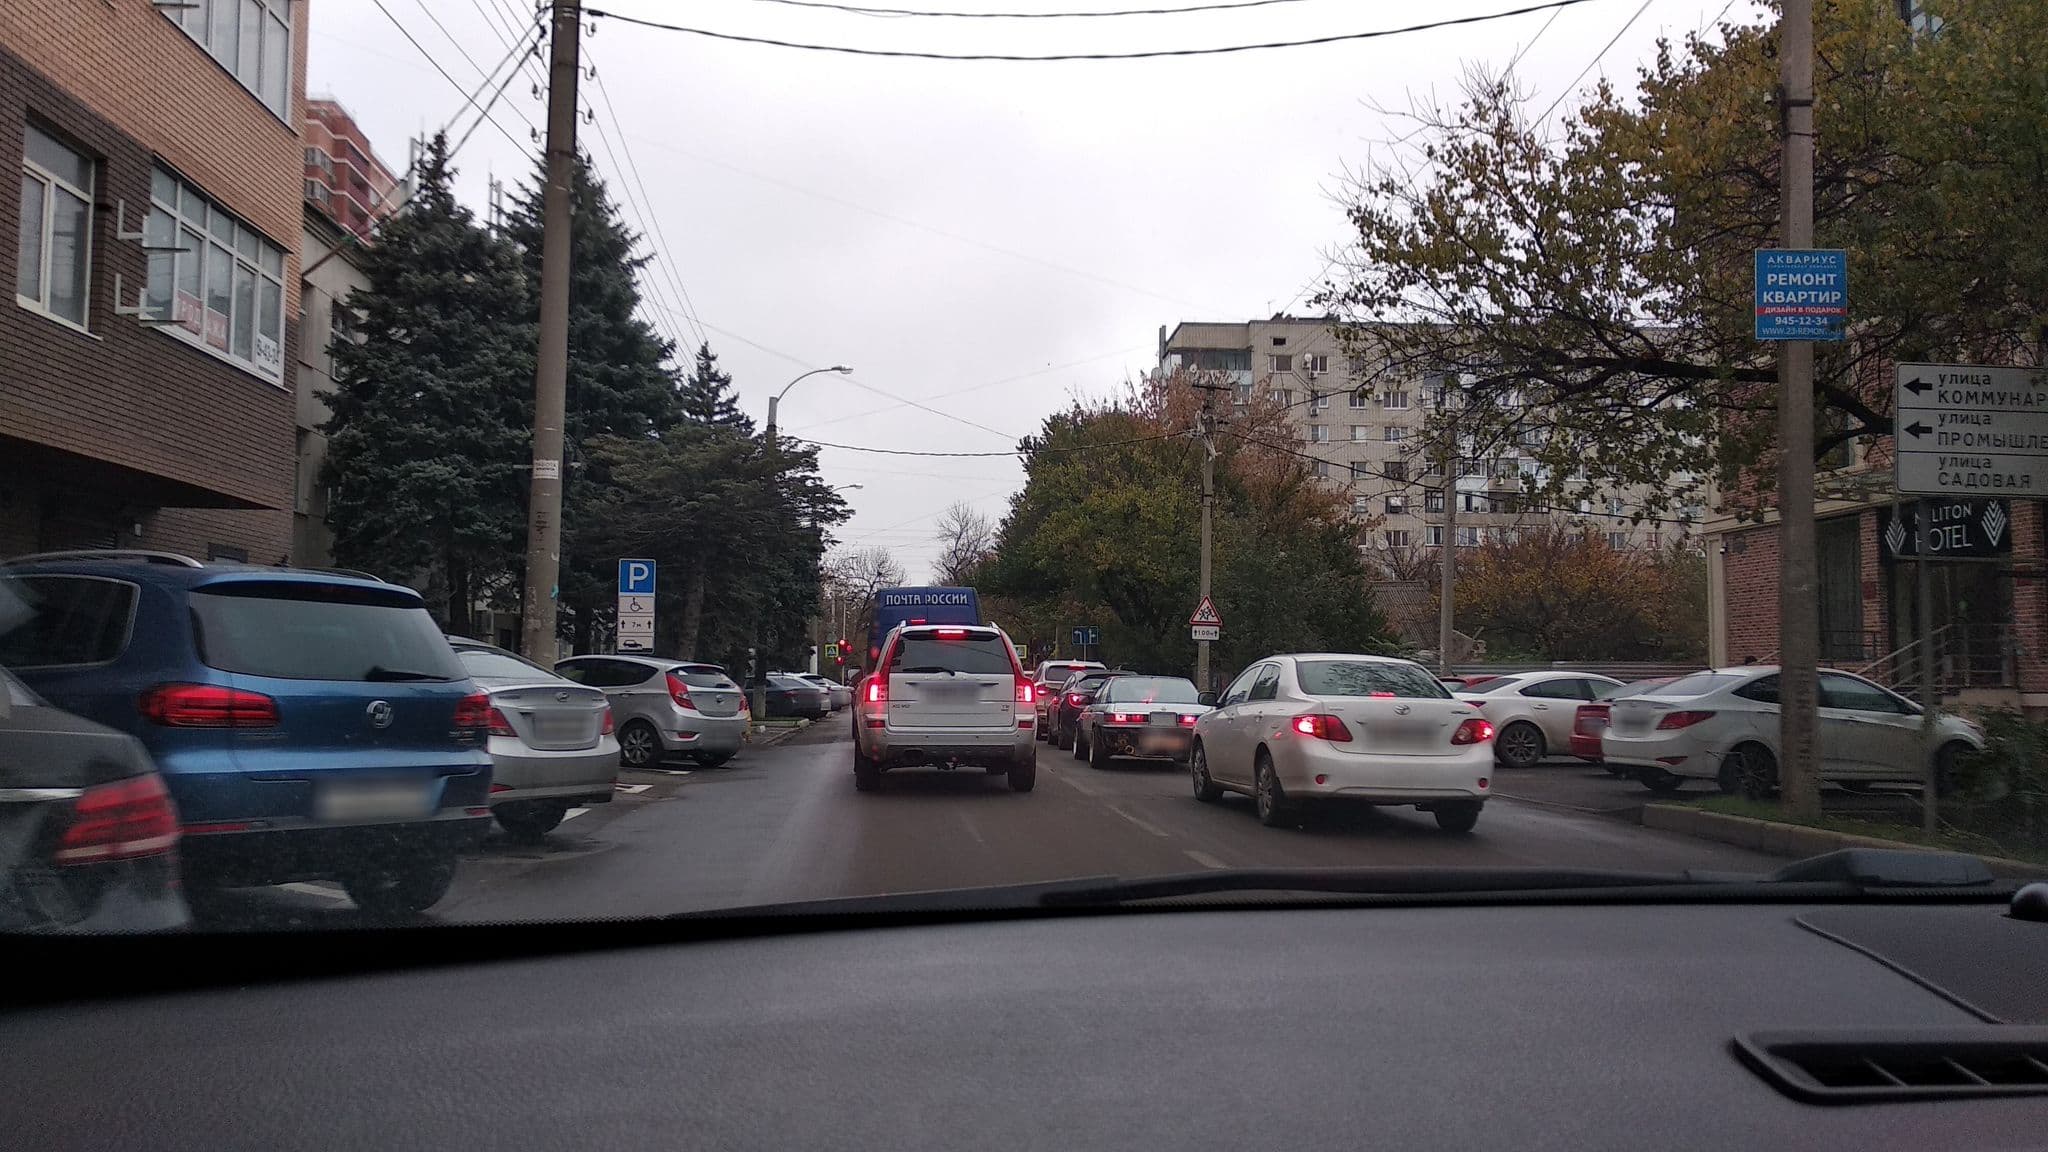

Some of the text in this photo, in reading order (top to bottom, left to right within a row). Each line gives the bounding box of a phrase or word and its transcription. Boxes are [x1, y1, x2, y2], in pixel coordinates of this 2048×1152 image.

[1767, 255, 1837, 264] АКВАРИУС
[1767, 273, 1837, 286] РЕМОНТ
[1763, 291, 1841, 304] КВАРТИР
[1775, 316, 1828, 325] 945-12-34
[1938, 373, 1991, 386] улица
[1938, 390, 2047, 406] КОММУНАР
[1938, 413, 1991, 427] улица
[1938, 455, 1993, 470] улица
[1938, 472, 2031, 489] САДОВАЯ
[629, 563, 649, 590] P
[886, 593, 968, 605] ПОЧТА РОССИИ
